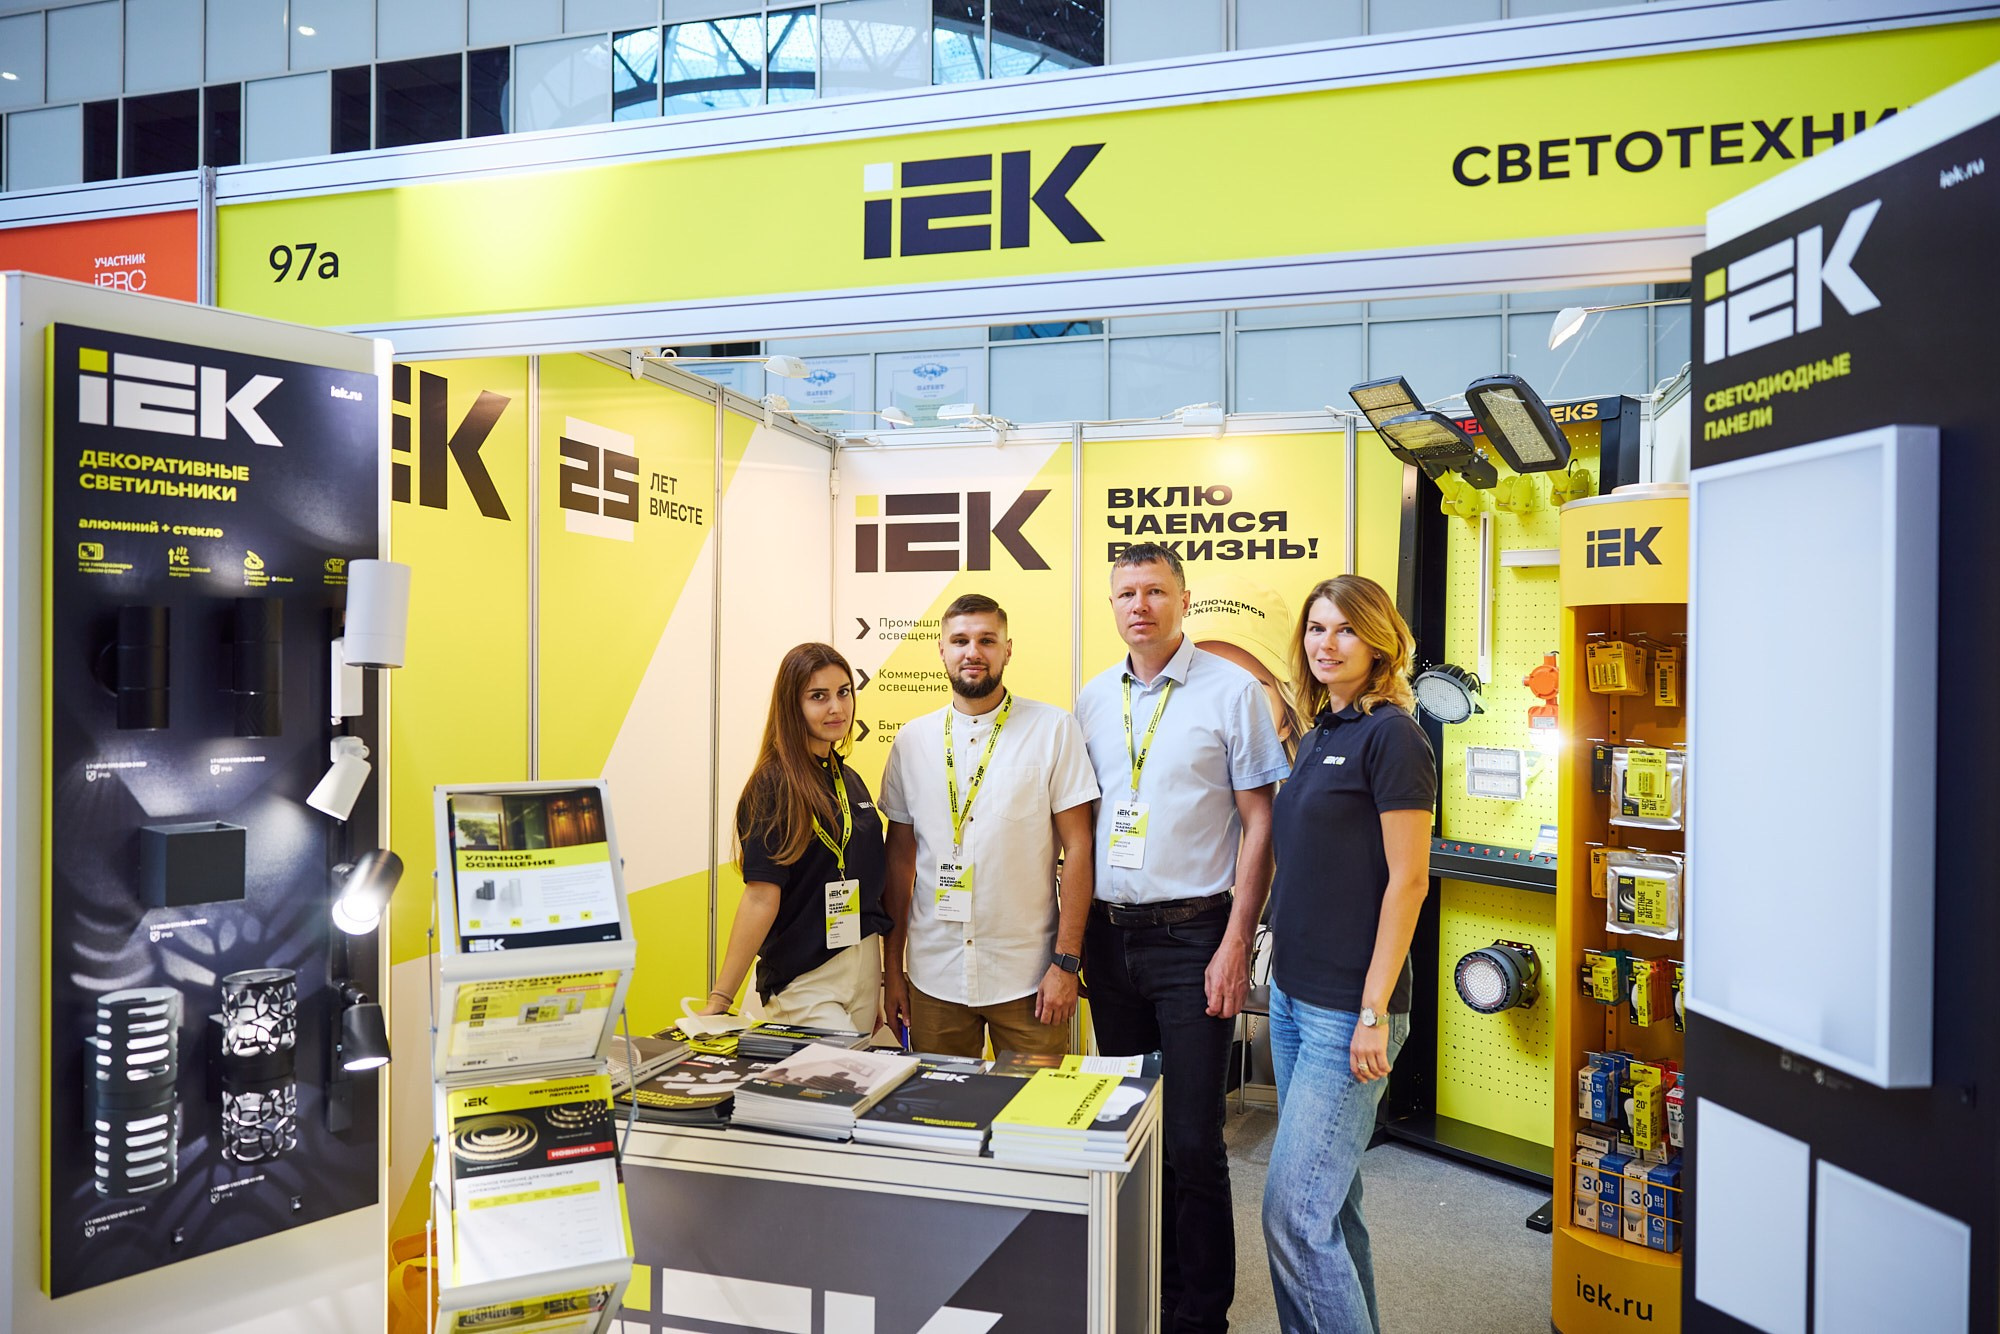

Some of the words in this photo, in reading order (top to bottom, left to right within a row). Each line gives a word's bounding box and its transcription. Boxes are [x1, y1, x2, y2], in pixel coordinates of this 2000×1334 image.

[1940, 159, 1985, 189] iek.ru
[864, 143, 1106, 260] iEK
[94, 253, 146, 268] УЧАСТНИК
[1705, 198, 1882, 364] iEK
[1704, 352, 1852, 413] СВЕТОДИОДНЫЕ
[79, 346, 284, 448] iEK
[1550, 402, 1599, 424] EKS
[1704, 405, 1773, 441] ПАНЕЛИ
[392, 363, 511, 521] K
[79, 449, 250, 482] ДЕКОРАТИВНЫЕ
[79, 473, 237, 502] СВЕТИЛЬНИКИ
[560, 435, 639, 523] 25
[650, 472, 677, 496] ЛЕТ
[1107, 485, 1233, 509] ВКЛЮ
[650, 497, 703, 526] ВМЕСТЕ
[1107, 511, 1288, 535] ЧАЕМСЯ
[78, 517, 159, 534] алюминий
[172, 525, 224, 539] стекло
[855, 489, 1052, 573] iEK
[1586, 526, 1664, 569] iEK
[878, 618, 941, 629] Промышл
[878, 631, 942, 642] освещени
[878, 669, 950, 681] Коммерчес
[878, 684, 949, 693] освещение
[878, 720, 906, 730] Быт
[465, 854, 533, 862] УЛИЧНОЕ
[465, 859, 556, 868] ОСВЕЩЕНИЕ
[529, 1084, 590, 1096] СВЕТОДИОДНАЯ
[1067, 1078, 1110, 1126] СВЕТОТЕХНИКА
[551, 1146, 596, 1158] НОВИНКА
[1582, 1176, 1603, 1193] 30
[1605, 1181, 1614, 1189] Вт
[1631, 1190, 1652, 1207] 30
[1601, 1221, 1612, 1229] E27
[1576, 1274, 1653, 1321] iek.ru
